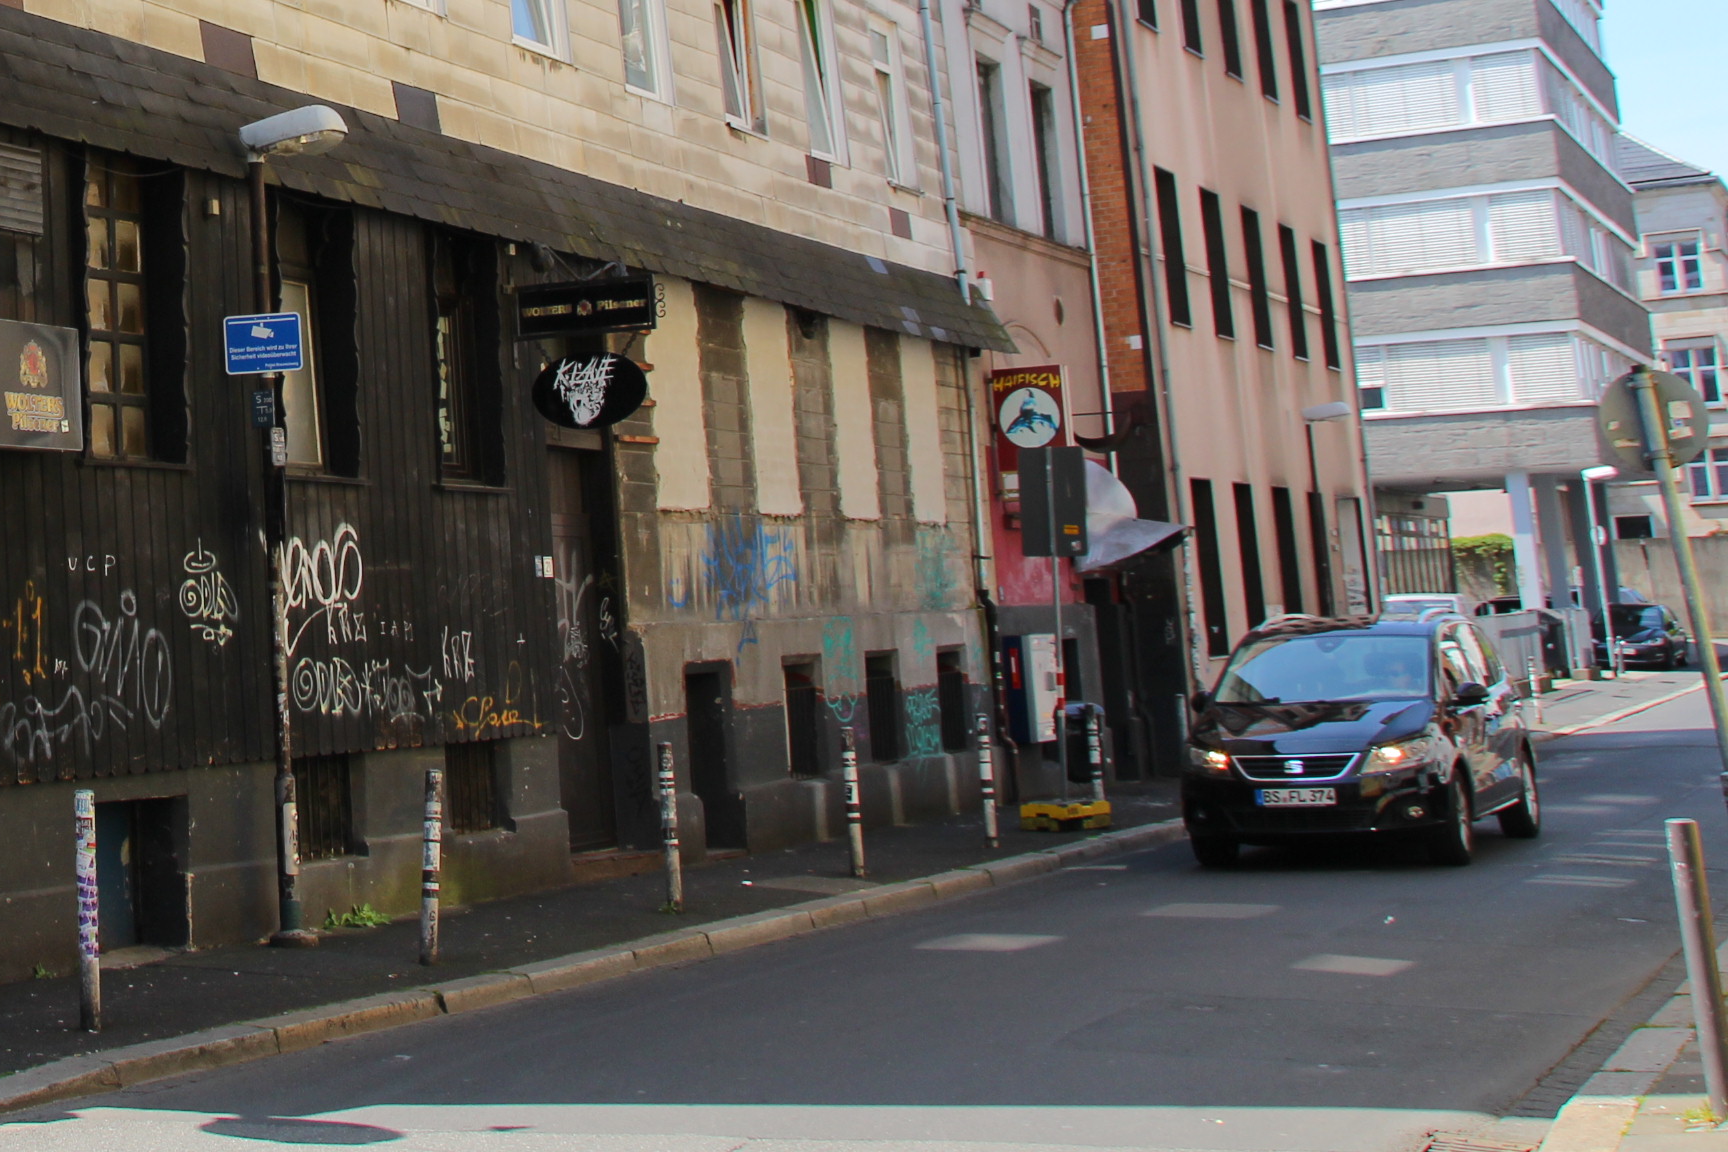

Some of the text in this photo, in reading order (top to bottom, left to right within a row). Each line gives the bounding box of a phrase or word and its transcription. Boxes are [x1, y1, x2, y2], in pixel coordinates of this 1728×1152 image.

[993, 372, 1062, 393] HAIFISCH
[4, 391, 65, 419] WOLTERS
[12, 410, 60, 434] Pilsener
[1263, 789, 1335, 804] BS FL 374
